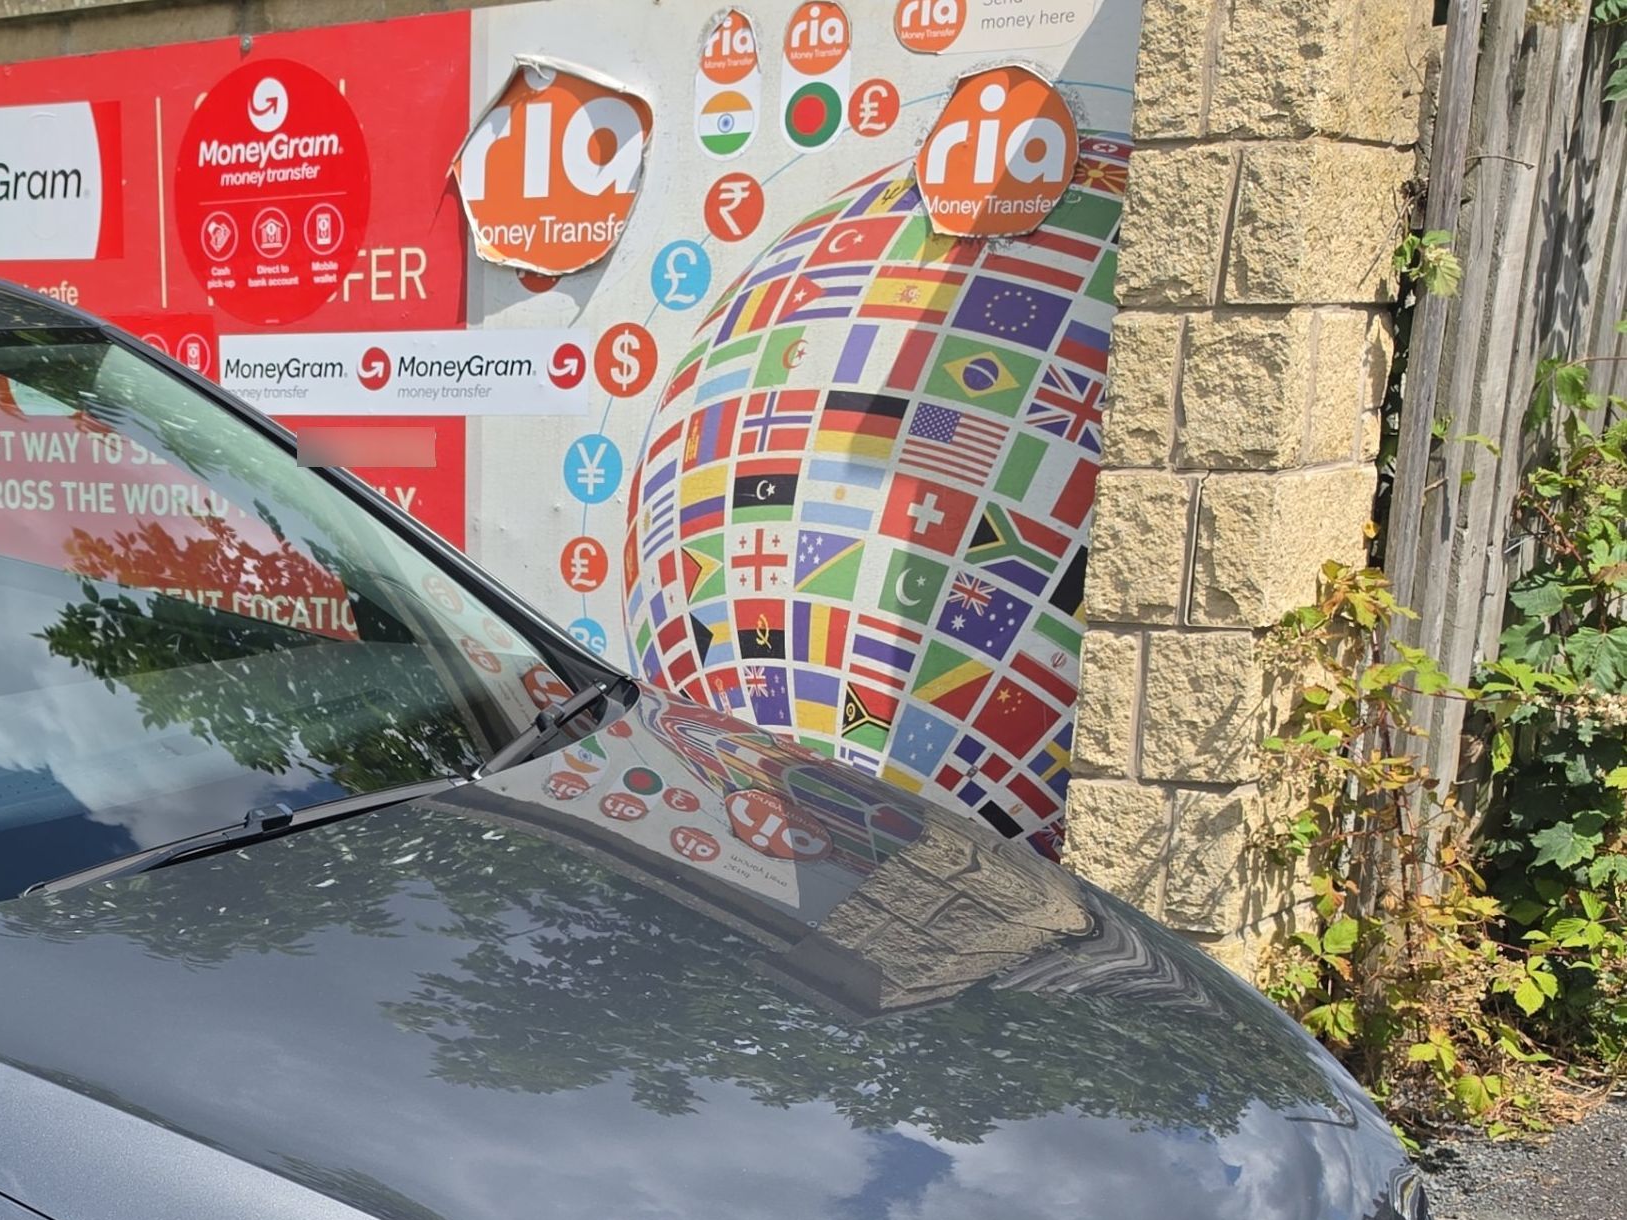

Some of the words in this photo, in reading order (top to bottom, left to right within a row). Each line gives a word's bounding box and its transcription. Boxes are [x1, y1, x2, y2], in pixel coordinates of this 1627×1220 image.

[901, 0, 958, 28] ria
[981, 14, 1035, 30] money
[1039, 10, 1076, 25] here
[704, 16, 754, 57] ria
[791, 6, 844, 48] ria
[791, 51, 814, 60] Money
[815, 48, 843, 58] Transfer
[460, 68, 645, 201] ria
[925, 83, 1067, 184] ria
[198, 132, 339, 168] MoneyGram
[220, 167, 267, 188] money
[266, 163, 321, 182] transfer
[925, 194, 982, 219] Money
[475, 217, 536, 251] oney
[539, 213, 624, 244] Transfe
[211, 266, 231, 276] Cash
[256, 264, 281, 275] Direct
[280, 264, 290, 274] to
[311, 261, 338, 272] Mobile
[313, 273, 337, 284] wallet
[207, 279, 236, 290] pick-up
[248, 277, 267, 288] bank
[268, 276, 299, 287] account
[224, 357, 343, 384] MoneyGram
[397, 355, 532, 383] MoneyGram
[263, 385, 309, 399] transfer
[397, 386, 438, 400] money
[441, 384, 492, 399] transfer
[20, 431, 81, 464] WAY
[86, 432, 123, 465] TO
[60, 480, 117, 514] THE
